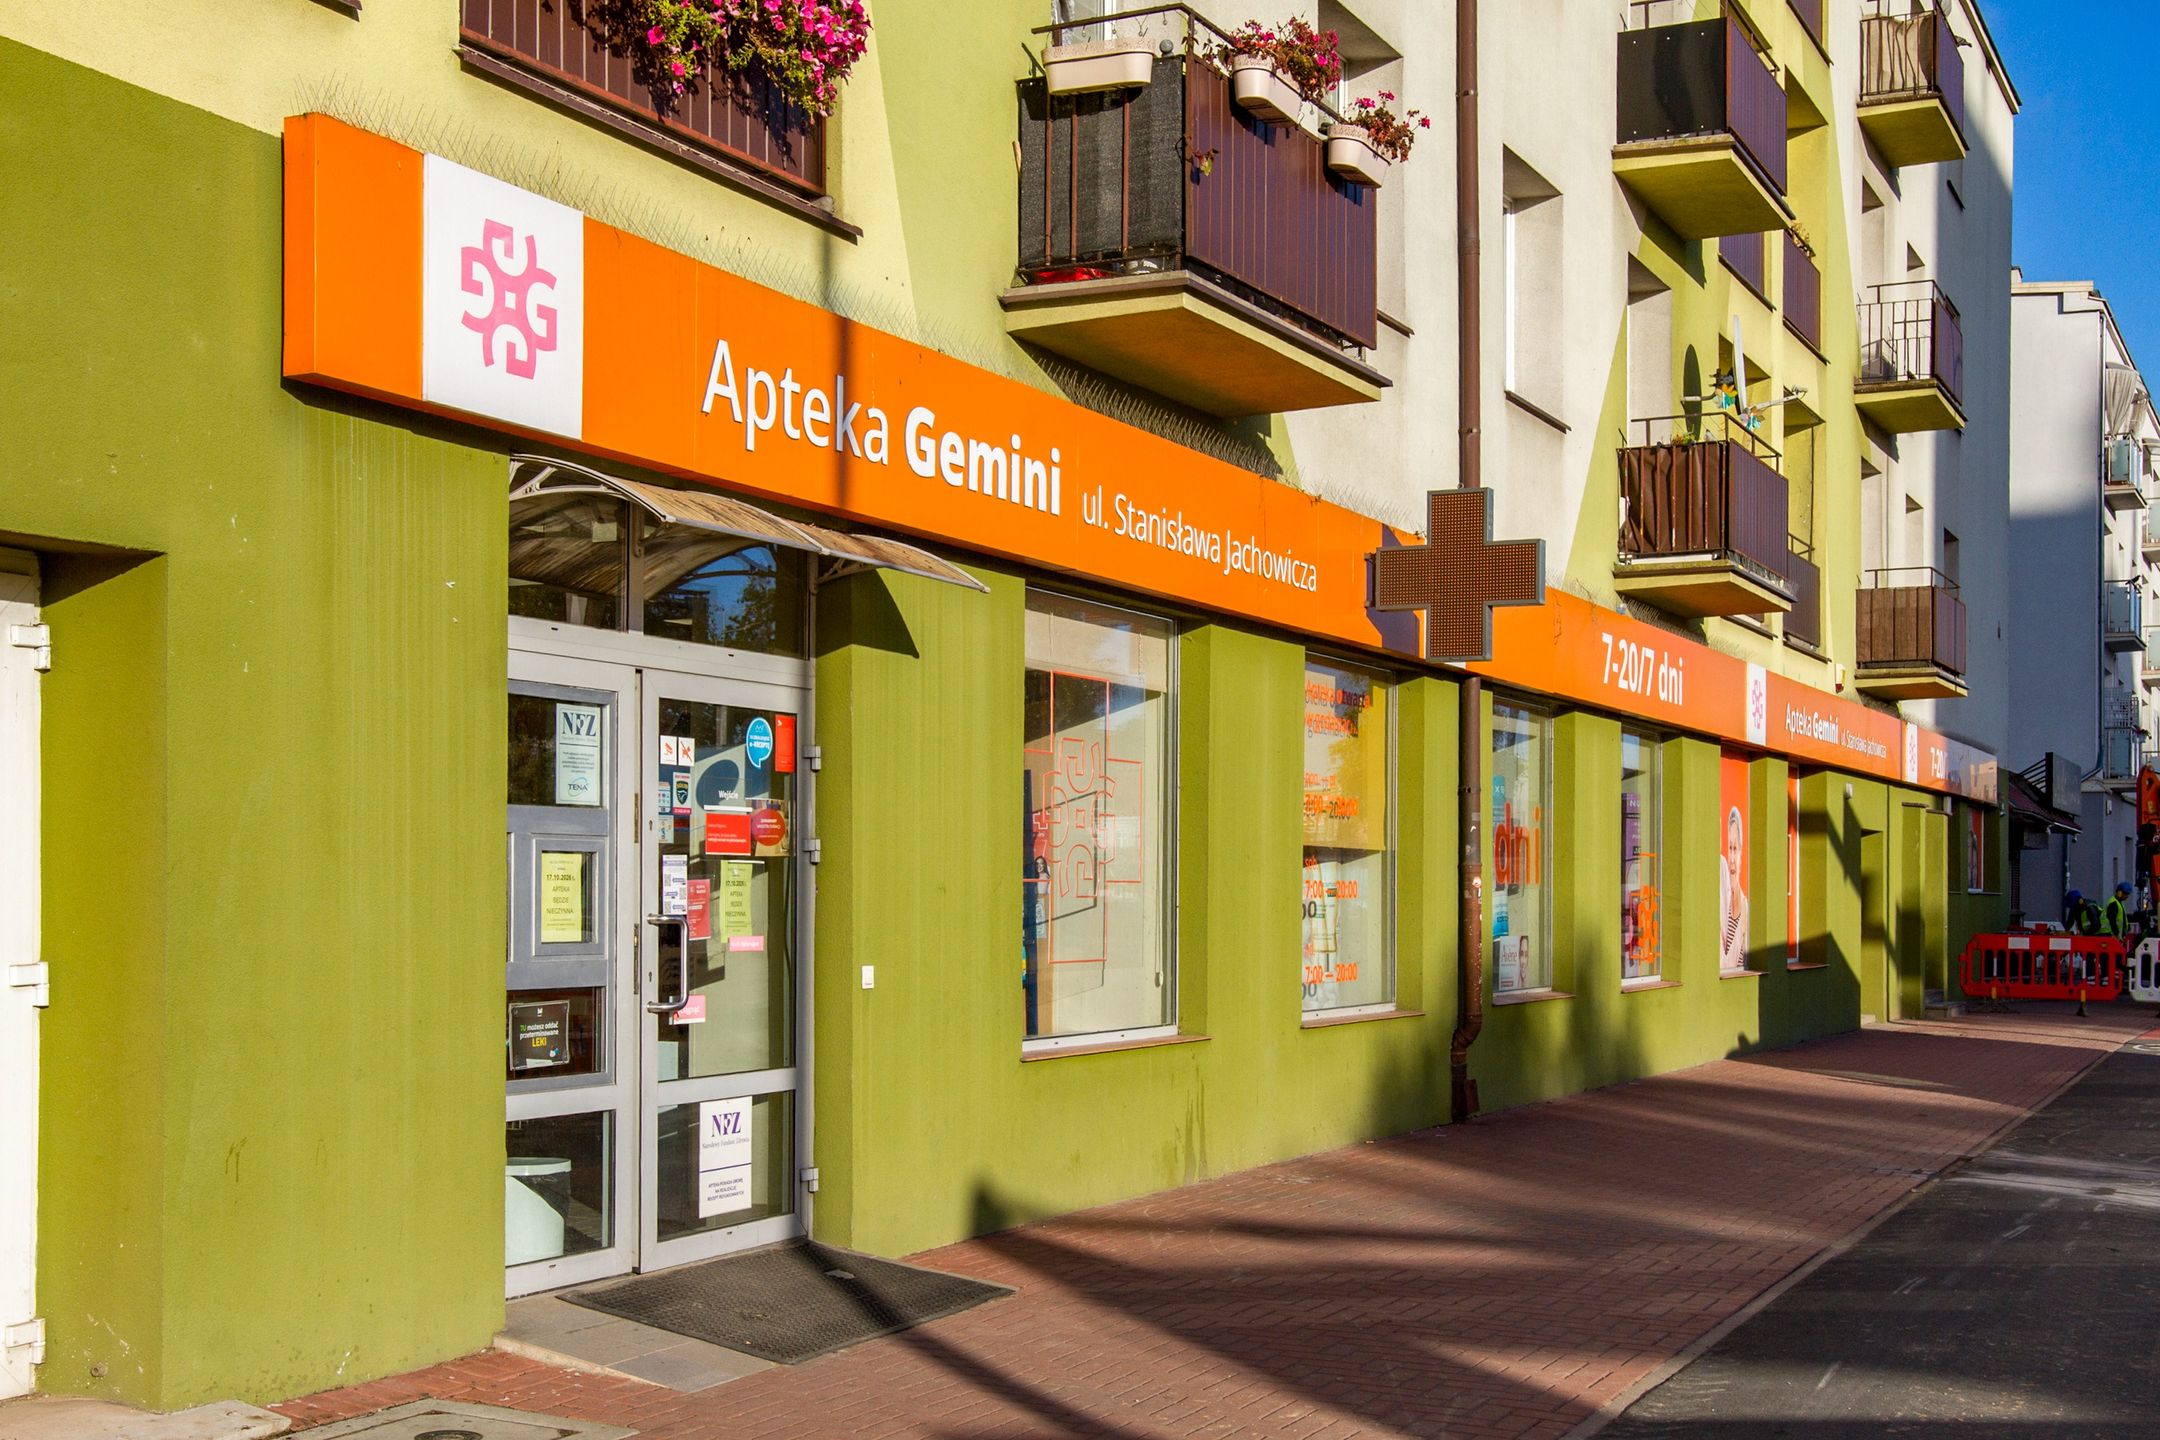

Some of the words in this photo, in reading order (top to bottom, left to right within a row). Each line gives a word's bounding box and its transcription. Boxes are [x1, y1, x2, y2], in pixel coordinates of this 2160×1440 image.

[701, 338, 889, 466] Apteka
[904, 406, 1061, 516] Gemini
[1082, 484, 1109, 530] ul.
[1113, 492, 1221, 564] Stanisława
[1224, 529, 1317, 593] Jachowicza
[1601, 631, 1655, 697] 7-20/7
[1658, 651, 1683, 706] dni
[562, 711, 597, 737] NFZ
[1785, 702, 1812, 741] Apteka
[1812, 711, 1839, 745] Gemini
[567, 783, 589, 791] TENA
[1494, 801, 1541, 885] dni
[1305, 880, 1323, 898] 7:00
[1336, 880, 1358, 898] 20:00
[1305, 965, 1323, 984] 7:00
[1336, 963, 1358, 982] 20:00
[520, 1024, 527, 1032] TU
[532, 1037, 547, 1047] LEKI
[711, 1111, 742, 1137] NFZ
